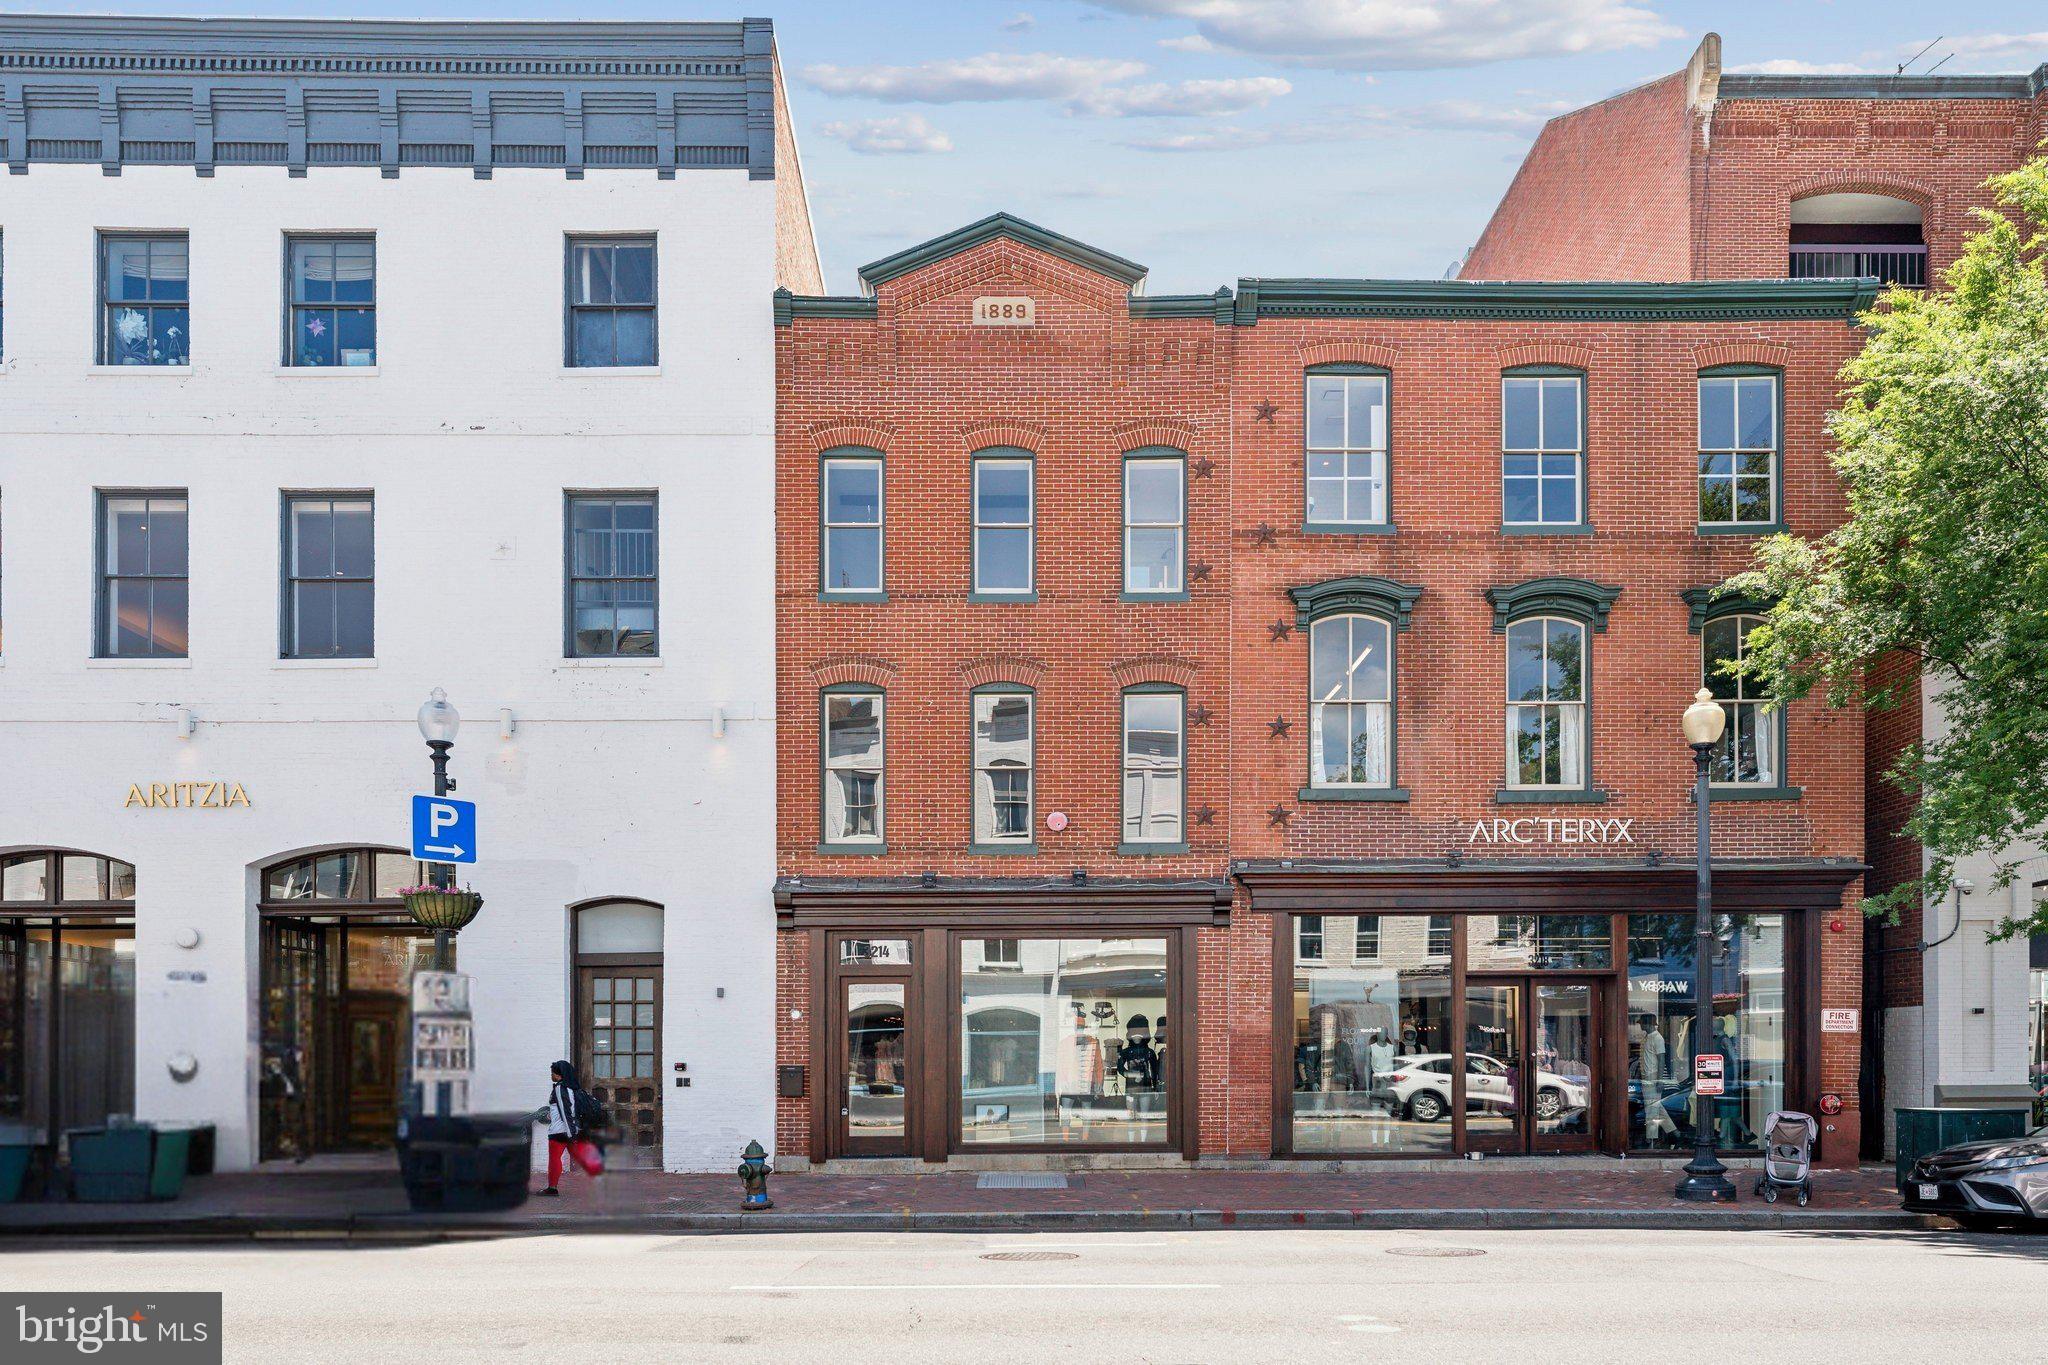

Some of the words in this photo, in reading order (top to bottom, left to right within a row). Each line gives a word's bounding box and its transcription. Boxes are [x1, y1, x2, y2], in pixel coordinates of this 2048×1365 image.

[981, 304, 1026, 319] 1889
[124, 782, 251, 808] ARITZIA
[430, 803, 459, 838] P
[1468, 816, 1635, 843] ARC'TERYX
[384, 953, 436, 967] ARIZI
[1829, 1012, 1851, 1020] FIRE
